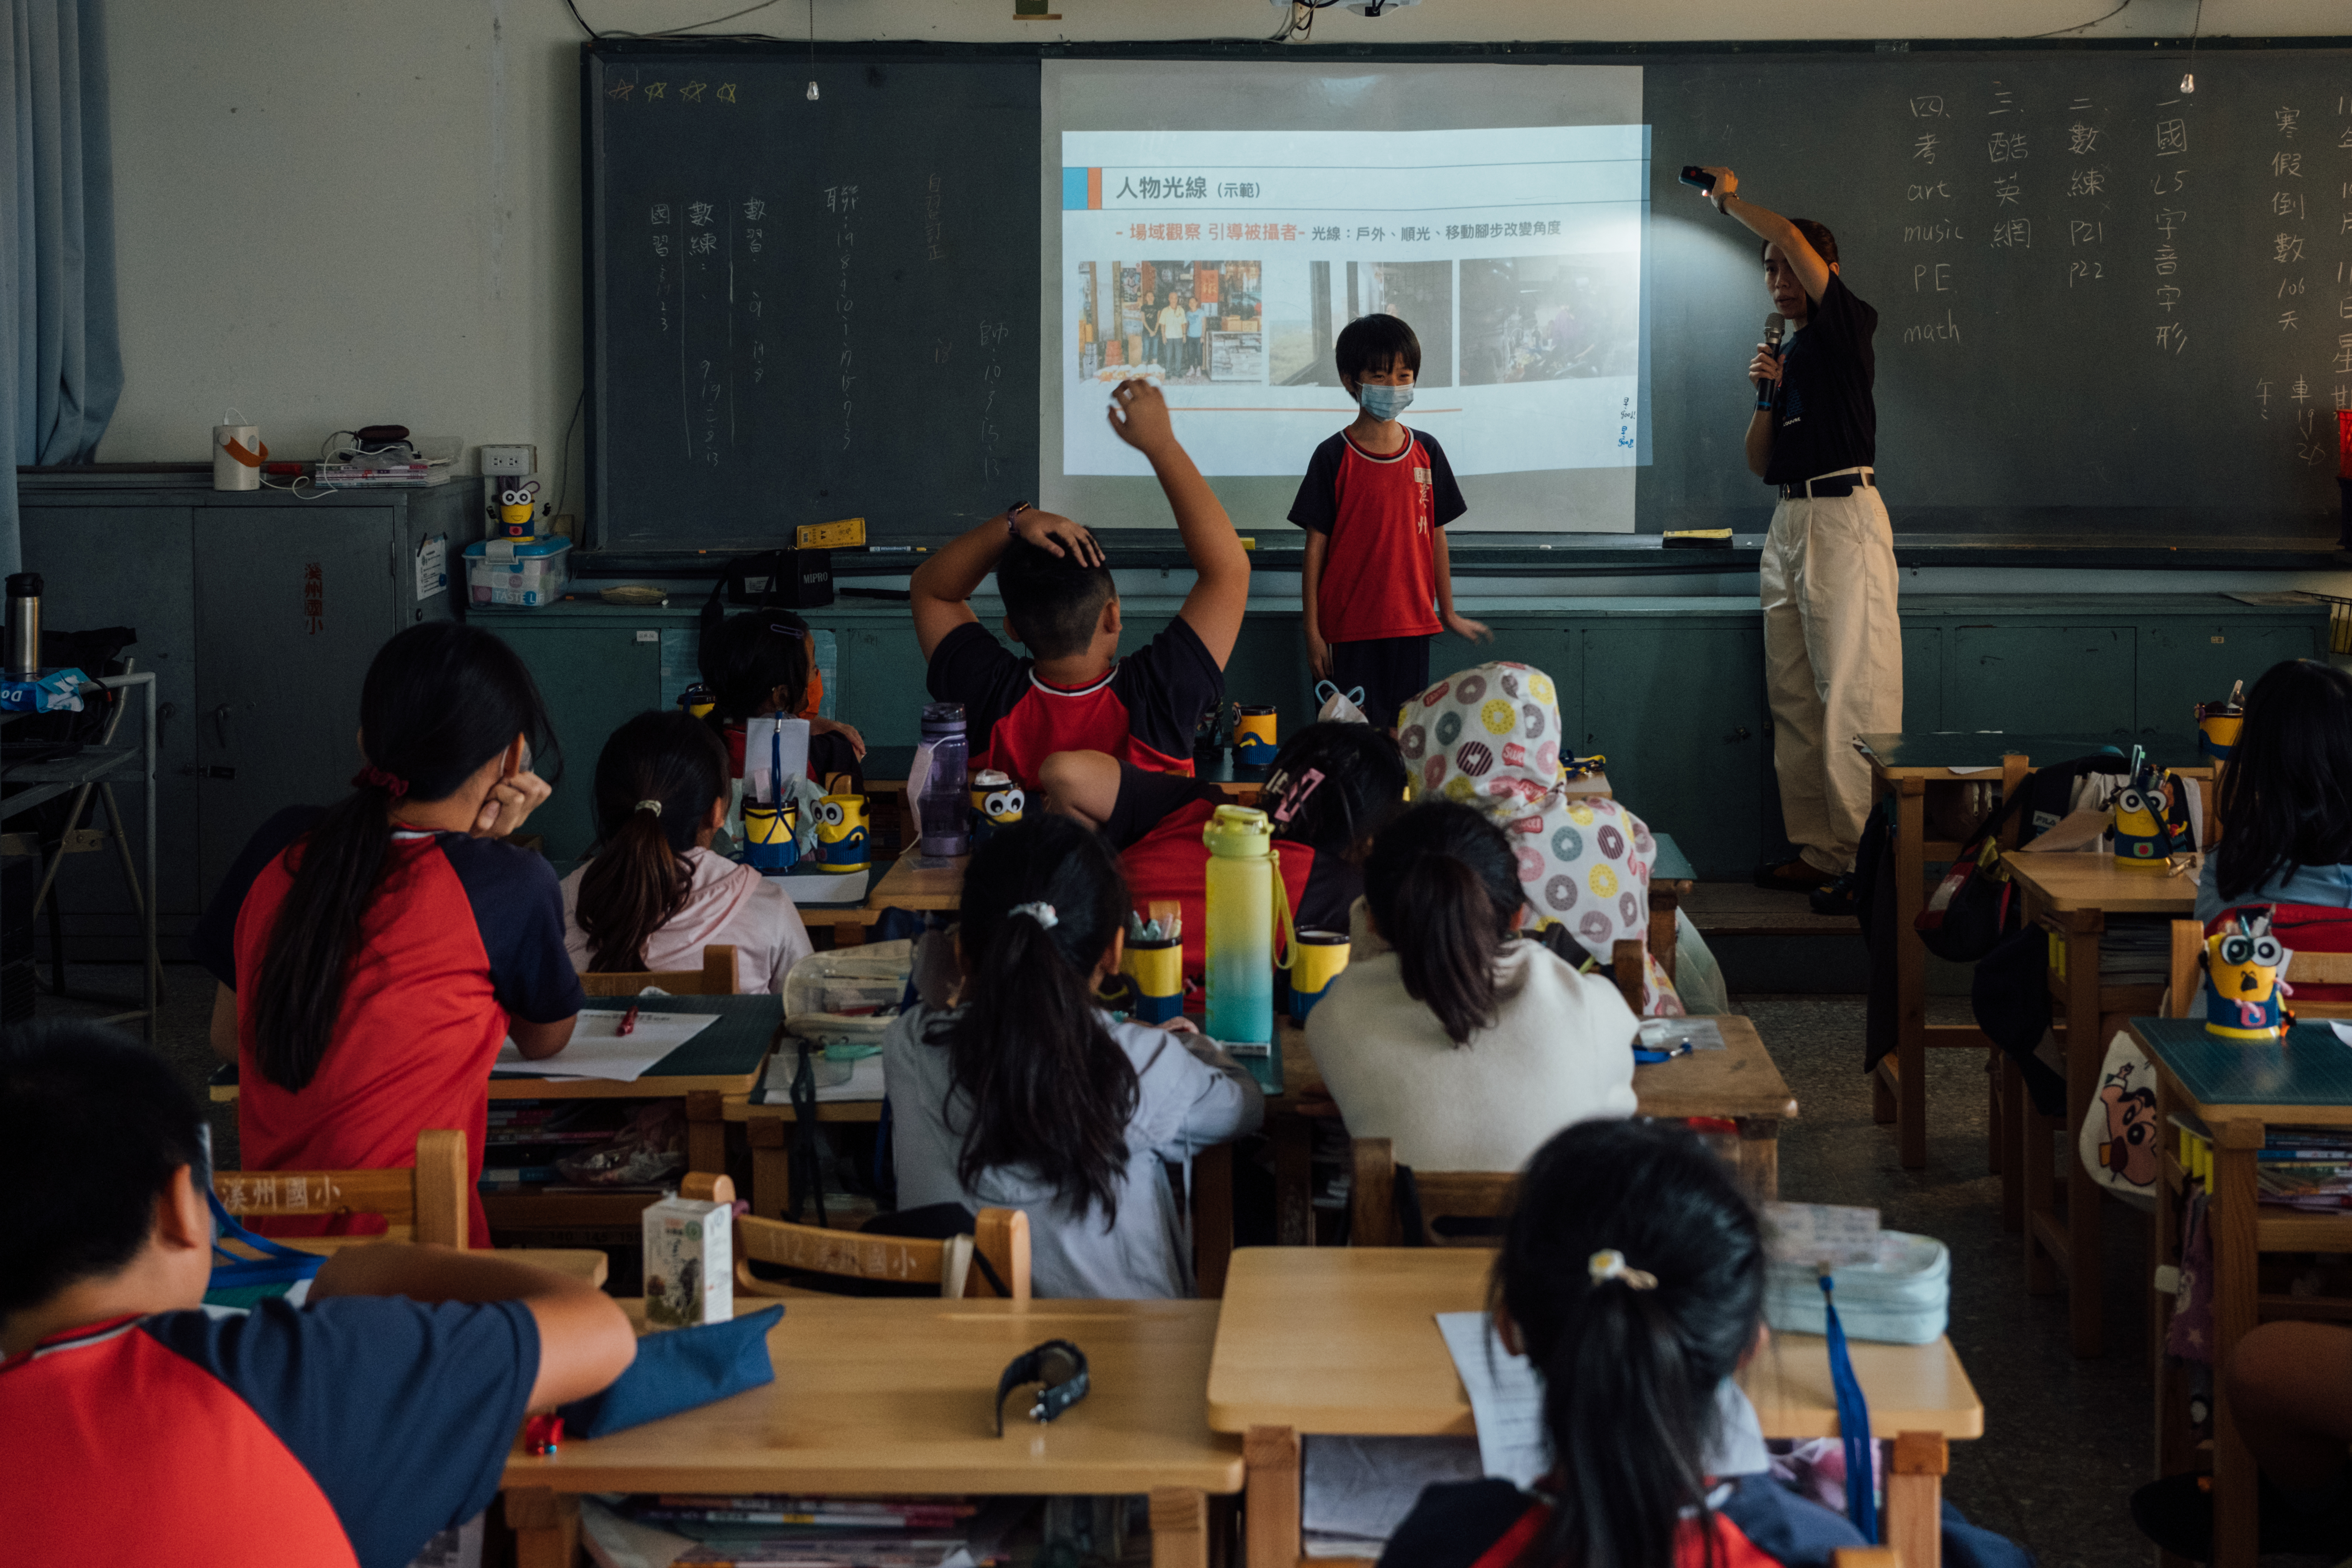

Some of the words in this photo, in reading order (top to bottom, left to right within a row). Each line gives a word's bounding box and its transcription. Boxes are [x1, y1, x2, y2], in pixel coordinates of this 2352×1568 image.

[1116, 176, 1207, 199] 人物光線
[1908, 181, 1950, 201] art
[1130, 223, 1201, 241] 場域觀察
[1905, 219, 1963, 242] music
[1905, 309, 1960, 343] math
[1783, 417, 1801, 427] LOUVRE
[803, 572, 828, 584] MIPRO
[305, 563, 323, 635] 溪州國小
